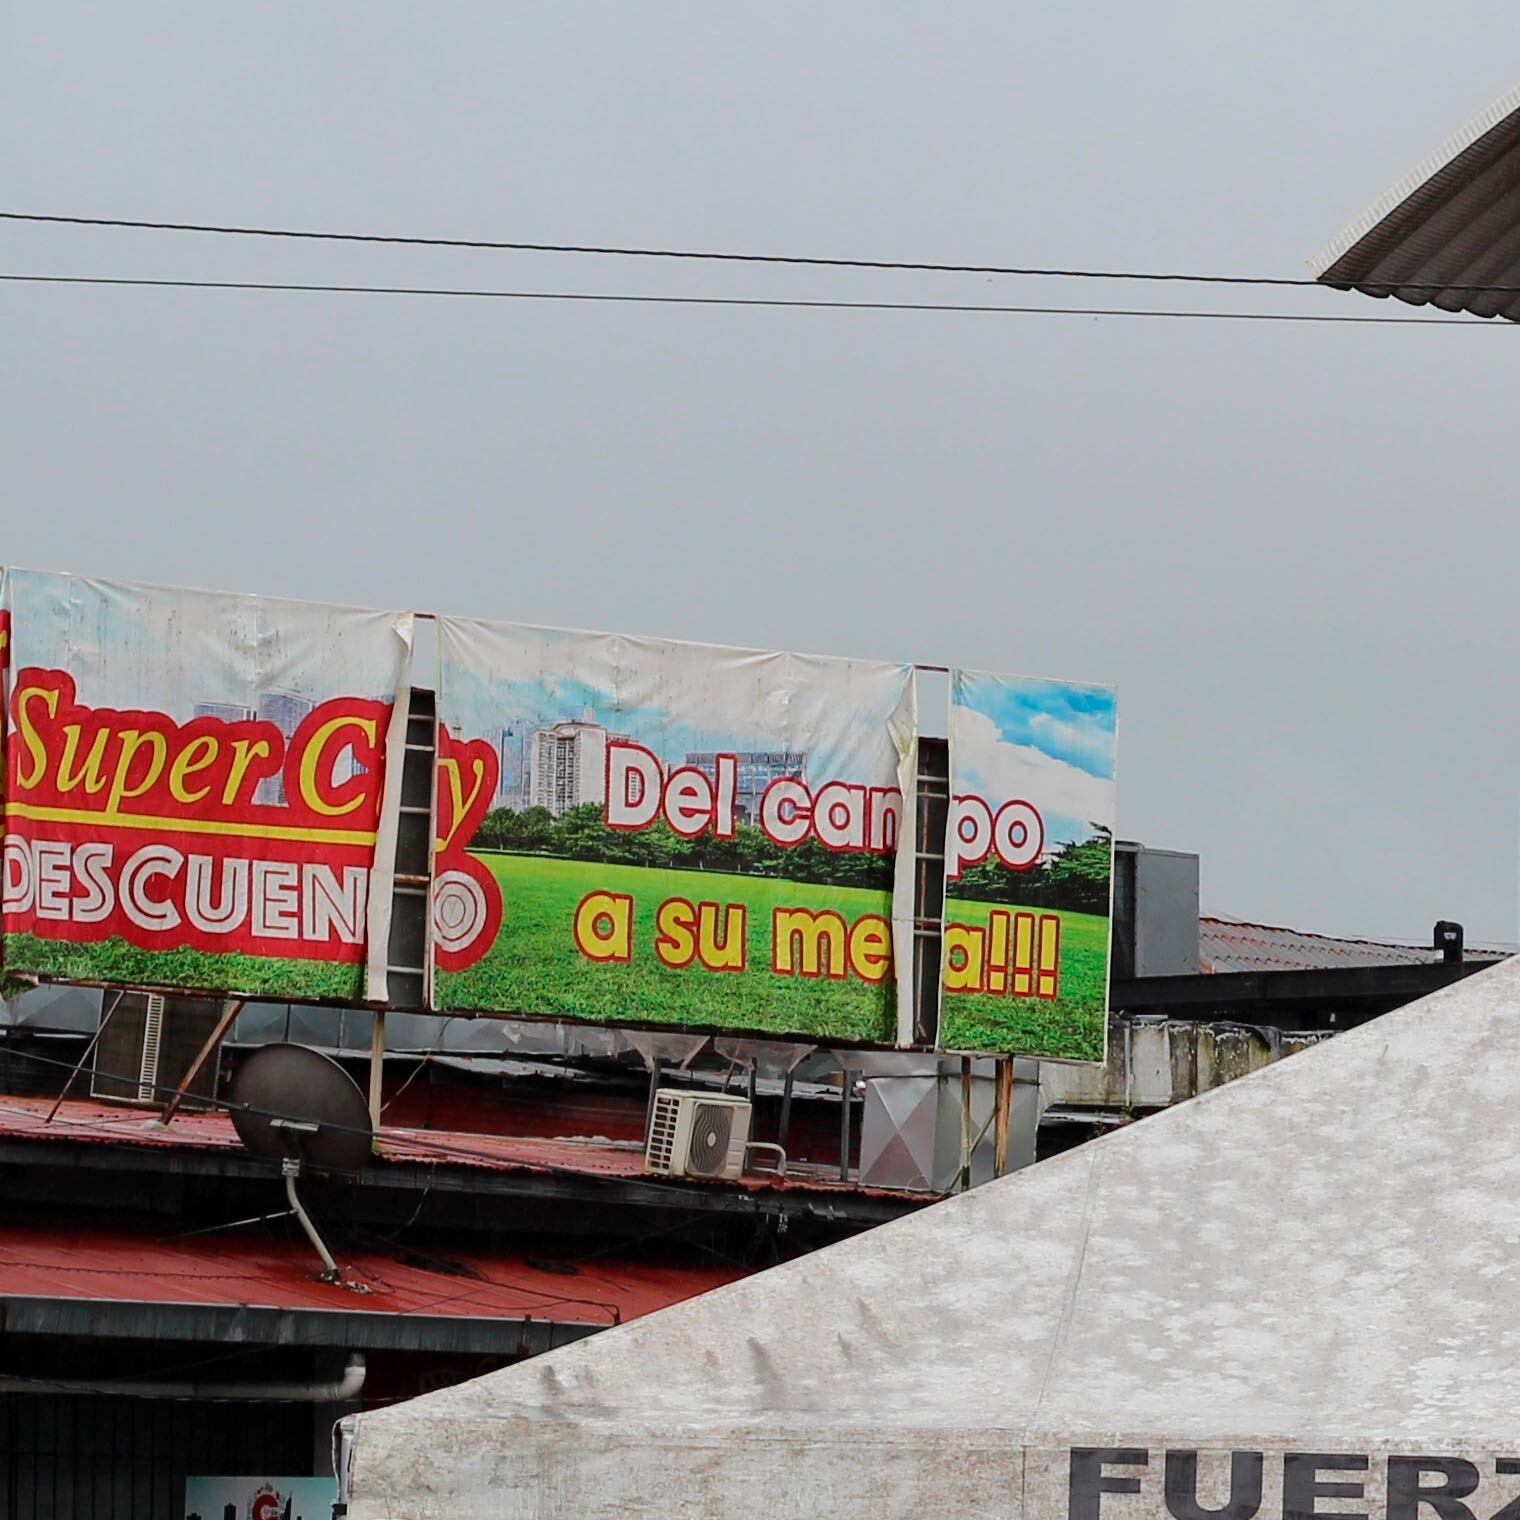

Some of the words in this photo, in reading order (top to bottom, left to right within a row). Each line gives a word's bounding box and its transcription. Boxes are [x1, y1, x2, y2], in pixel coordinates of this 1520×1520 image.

[17, 686, 270, 812] Super
[299, 715, 485, 853] Cy
[605, 741, 737, 840] Del
[3, 835, 487, 954] DESCUENO
[574, 889, 634, 963] a
[655, 896, 747, 973] su
[772, 906, 1060, 1001] mea!!!
